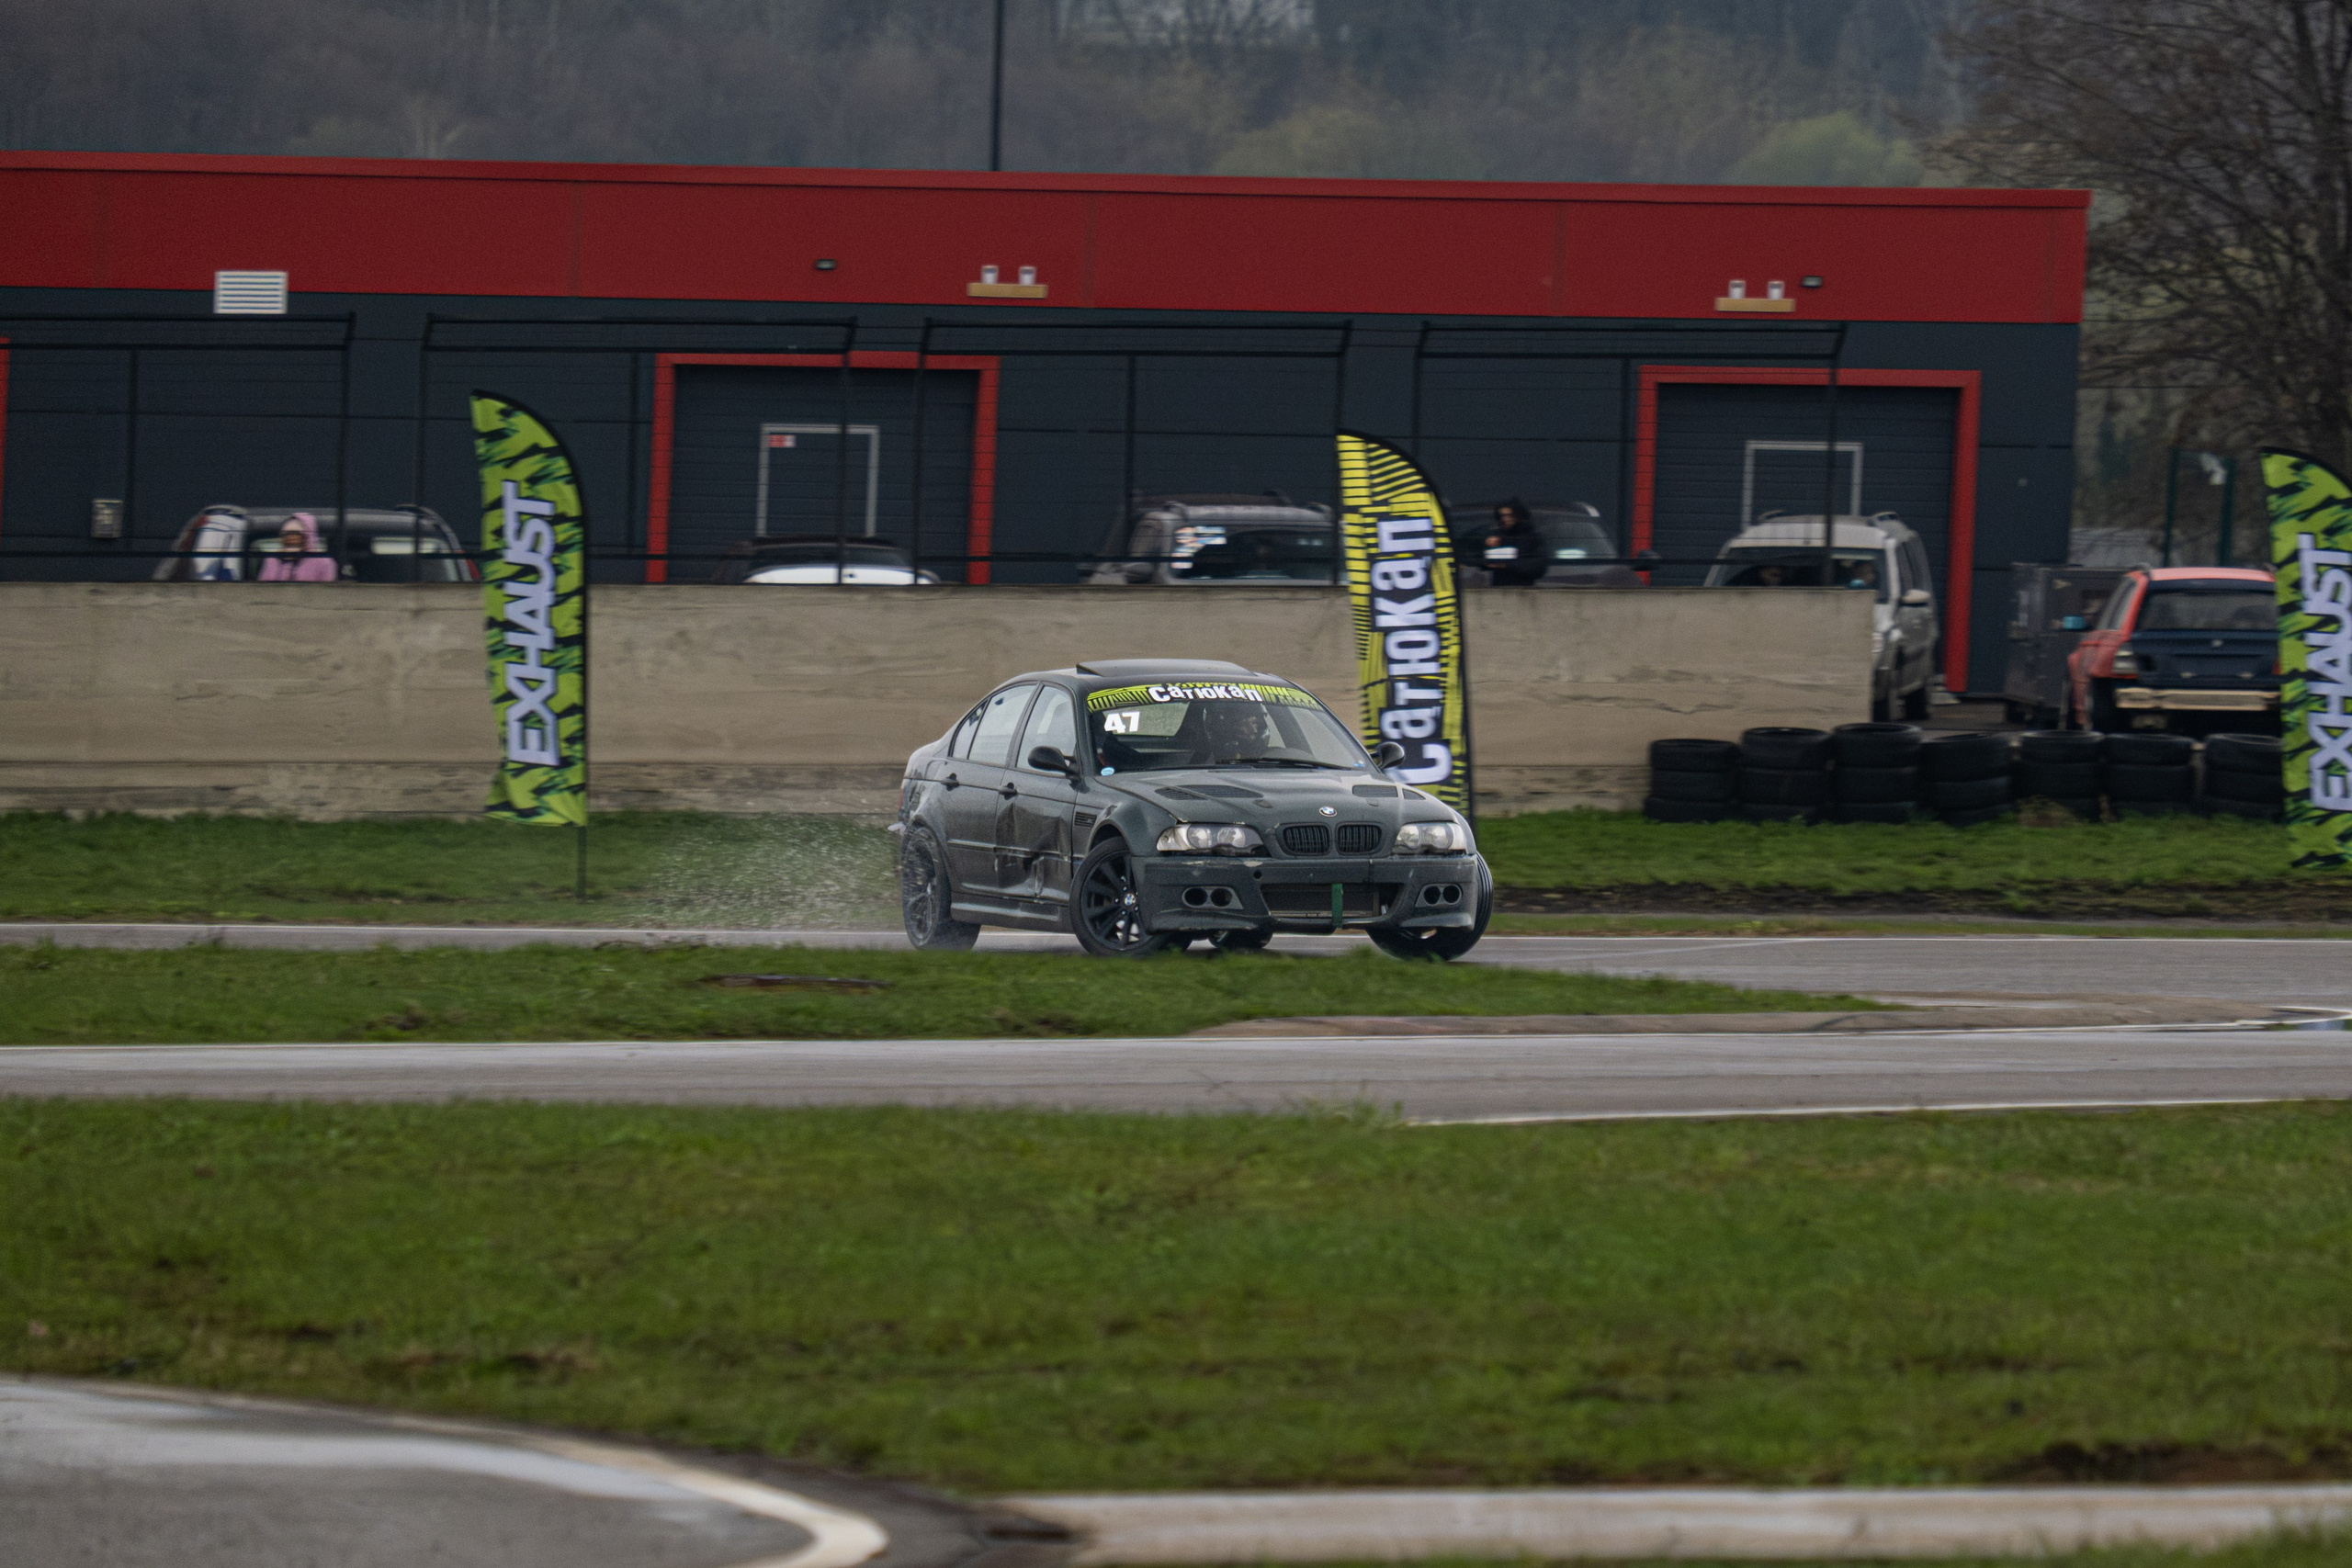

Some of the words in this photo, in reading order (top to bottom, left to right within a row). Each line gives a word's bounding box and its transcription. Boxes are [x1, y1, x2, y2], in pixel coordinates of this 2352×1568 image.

[502, 479, 560, 767] EXHAUST
[1103, 711, 1140, 733] 47
[2298, 532, 2352, 811] EXHAUST
